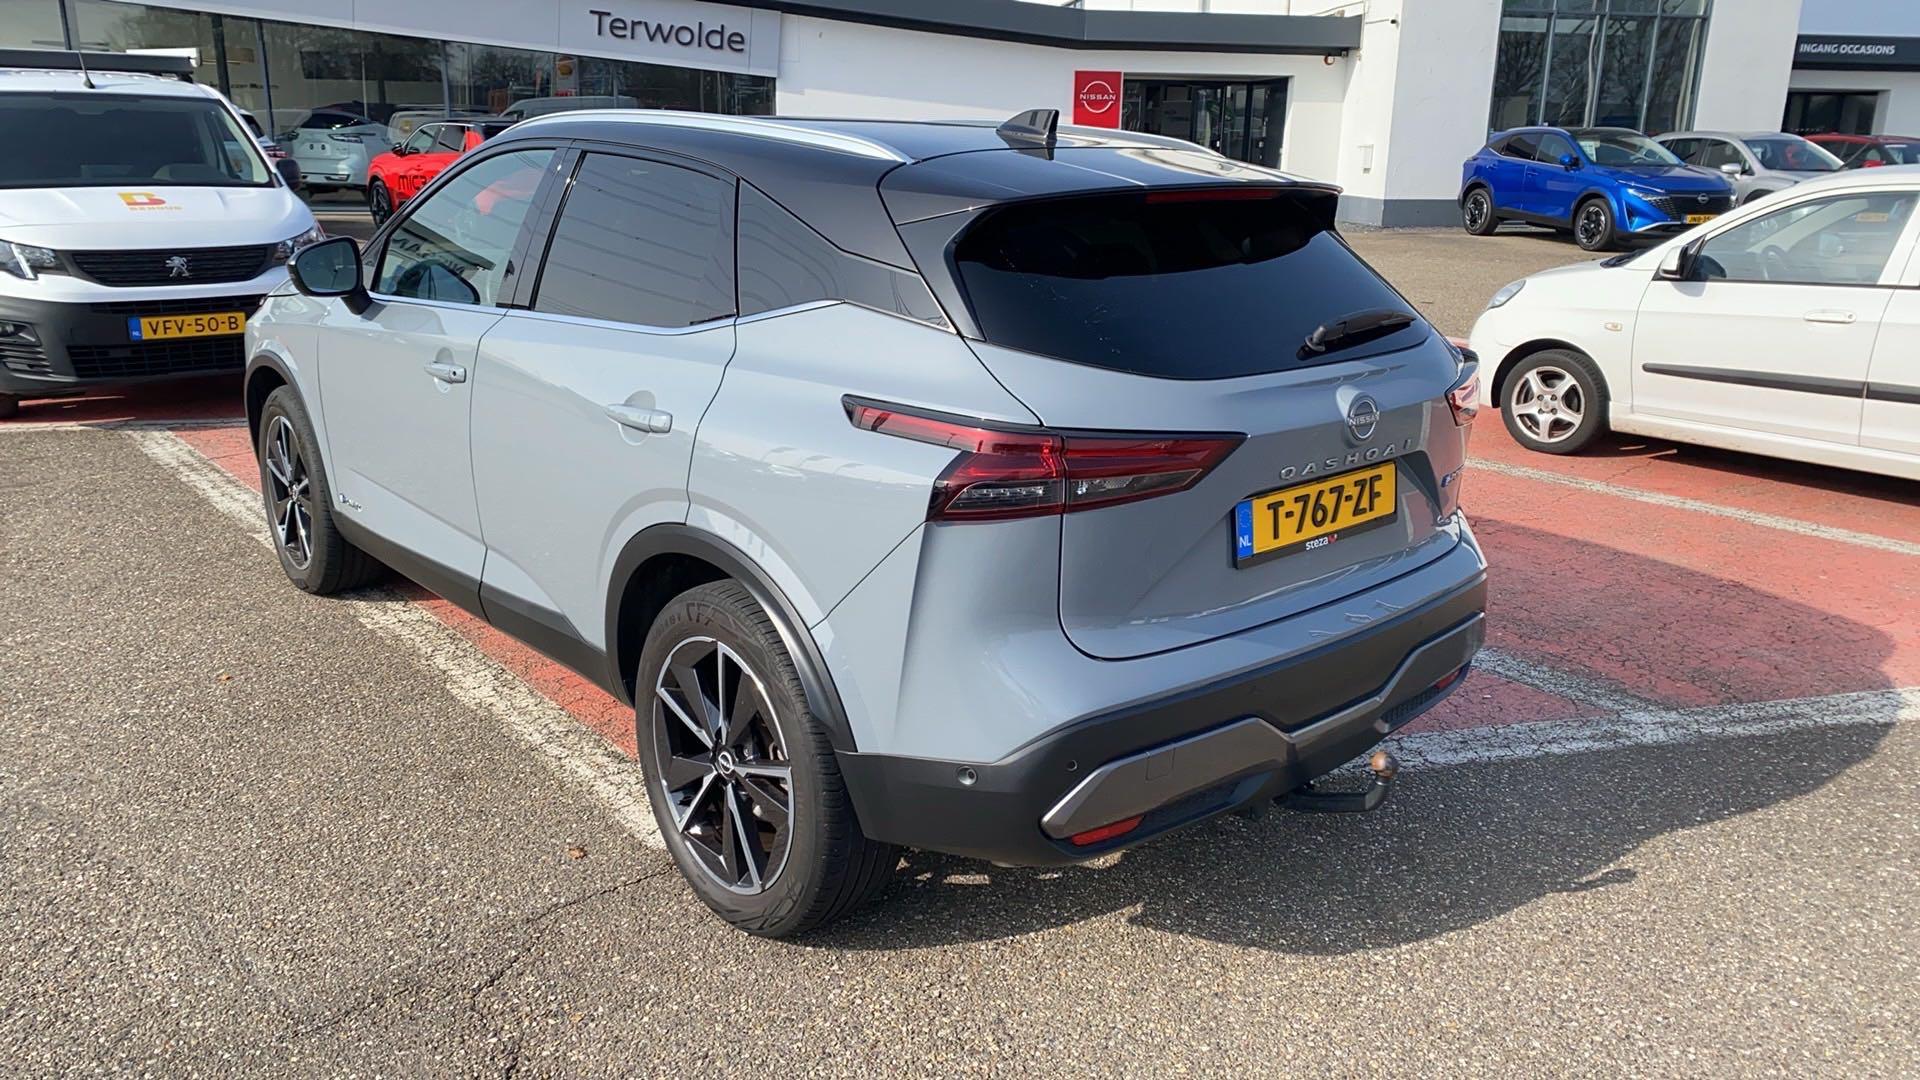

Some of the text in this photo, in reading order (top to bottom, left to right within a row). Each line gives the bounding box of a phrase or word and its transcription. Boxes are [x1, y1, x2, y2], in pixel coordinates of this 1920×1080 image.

[589, 9, 745, 52] Terwolde
[1800, 43, 1896, 55] INGANG OCCASIONS
[1080, 93, 1116, 101] NISSAN
[148, 315, 239, 336] VFV-50-B
[1348, 410, 1380, 426] NISSAN
[1280, 439, 1412, 480] QASHQAI
[1267, 474, 1382, 540] T-767-ZF
[1239, 534, 1252, 548] NL
[1305, 536, 1329, 551] steza
